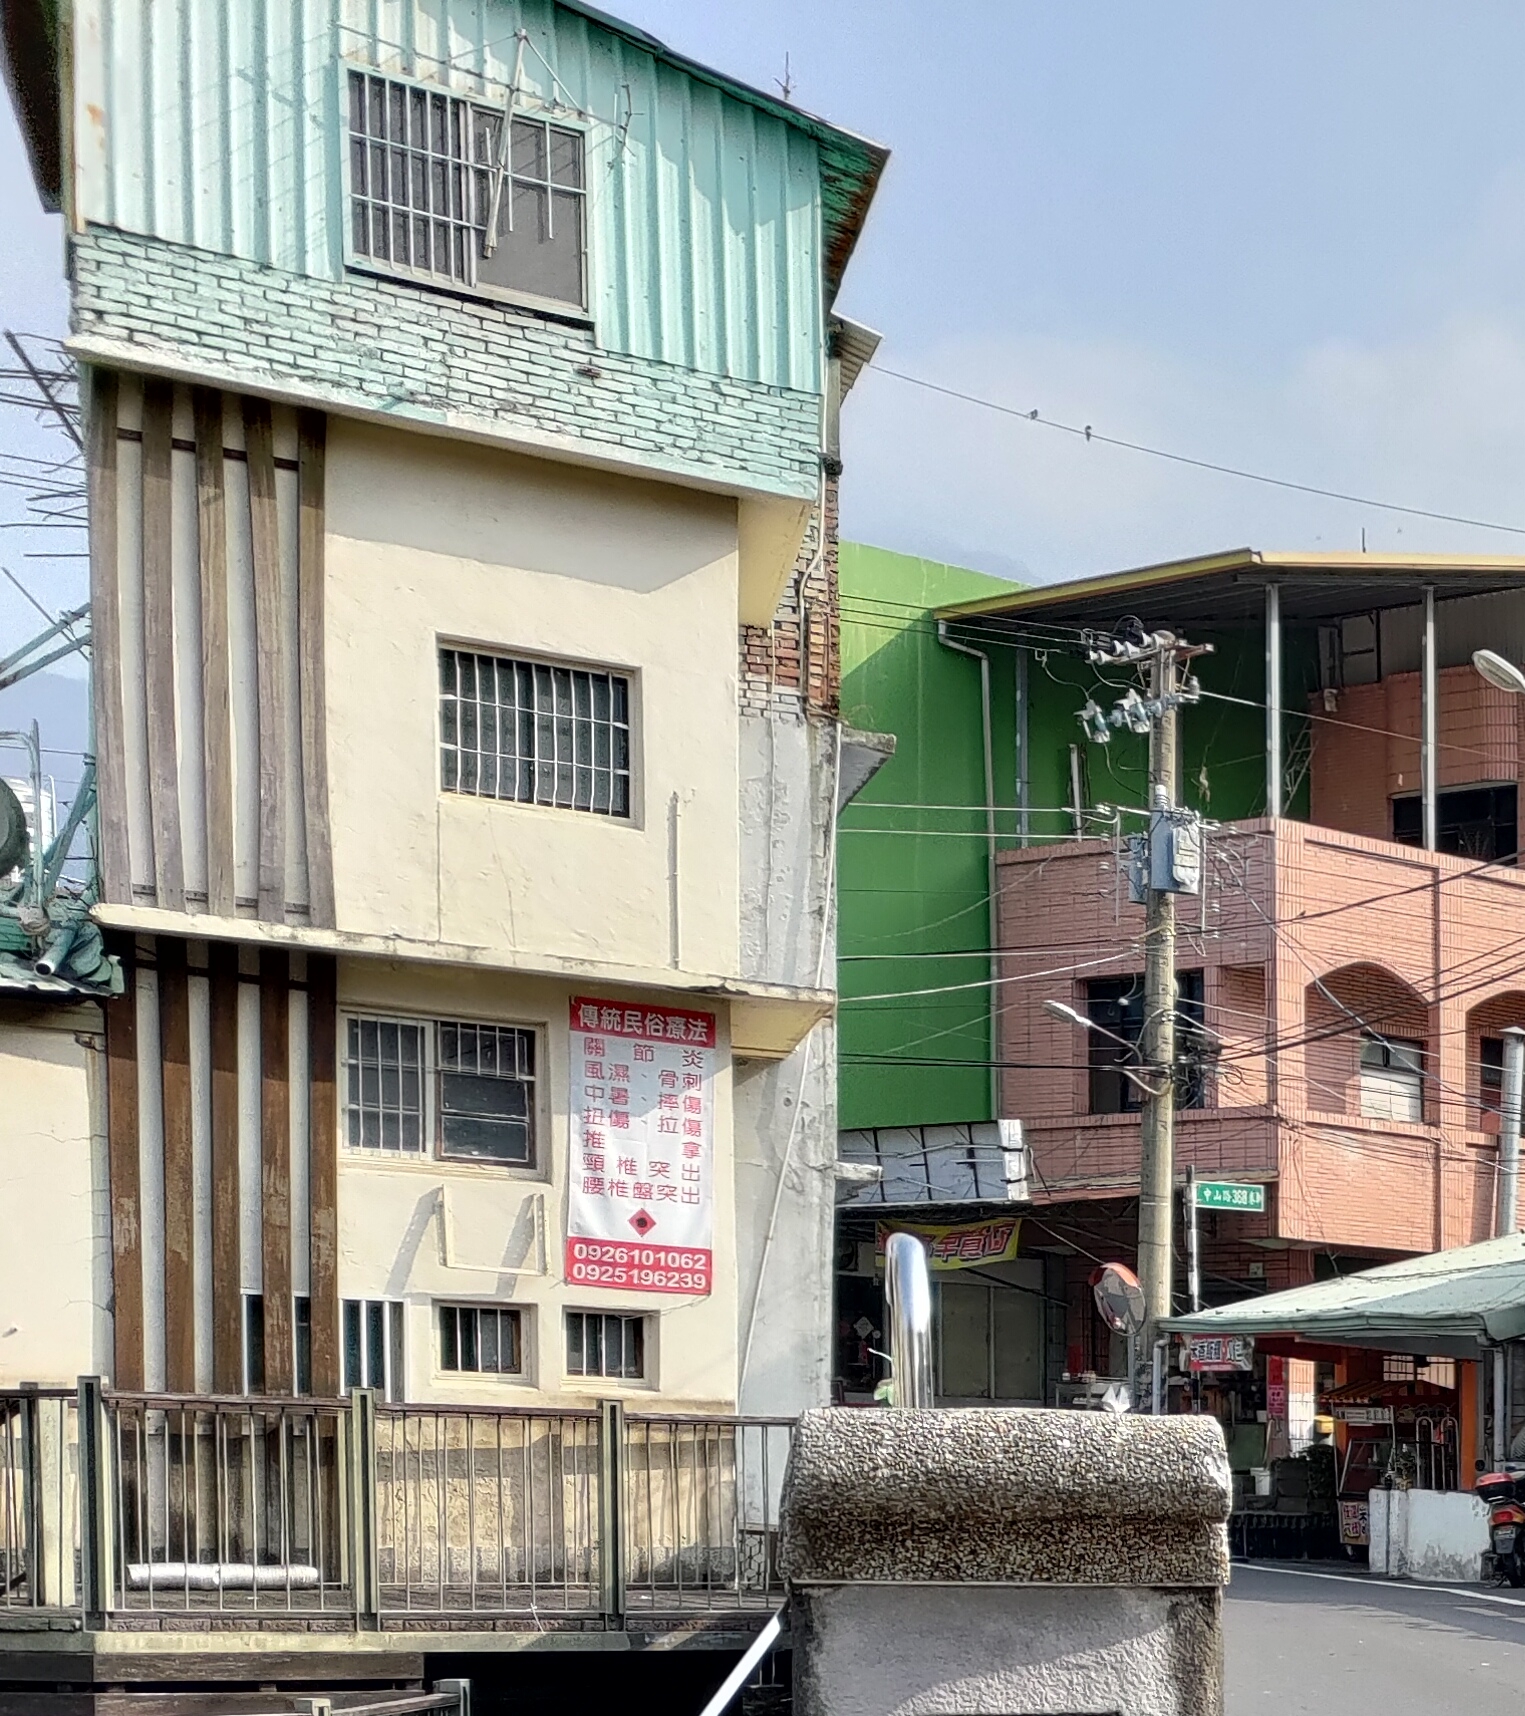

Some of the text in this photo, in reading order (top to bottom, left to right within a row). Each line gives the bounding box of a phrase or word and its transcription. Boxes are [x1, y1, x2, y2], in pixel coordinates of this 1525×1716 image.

[577, 1003, 709, 1042] 傳統民俗療法
[584, 1037, 704, 1069] 關節炎
[582, 1152, 701, 1183] 頸椎突出
[582, 1176, 701, 1205] 腰椎盤突出
[573, 1243, 706, 1270] 0926101062
[572, 1263, 706, 1290] 0925196239
